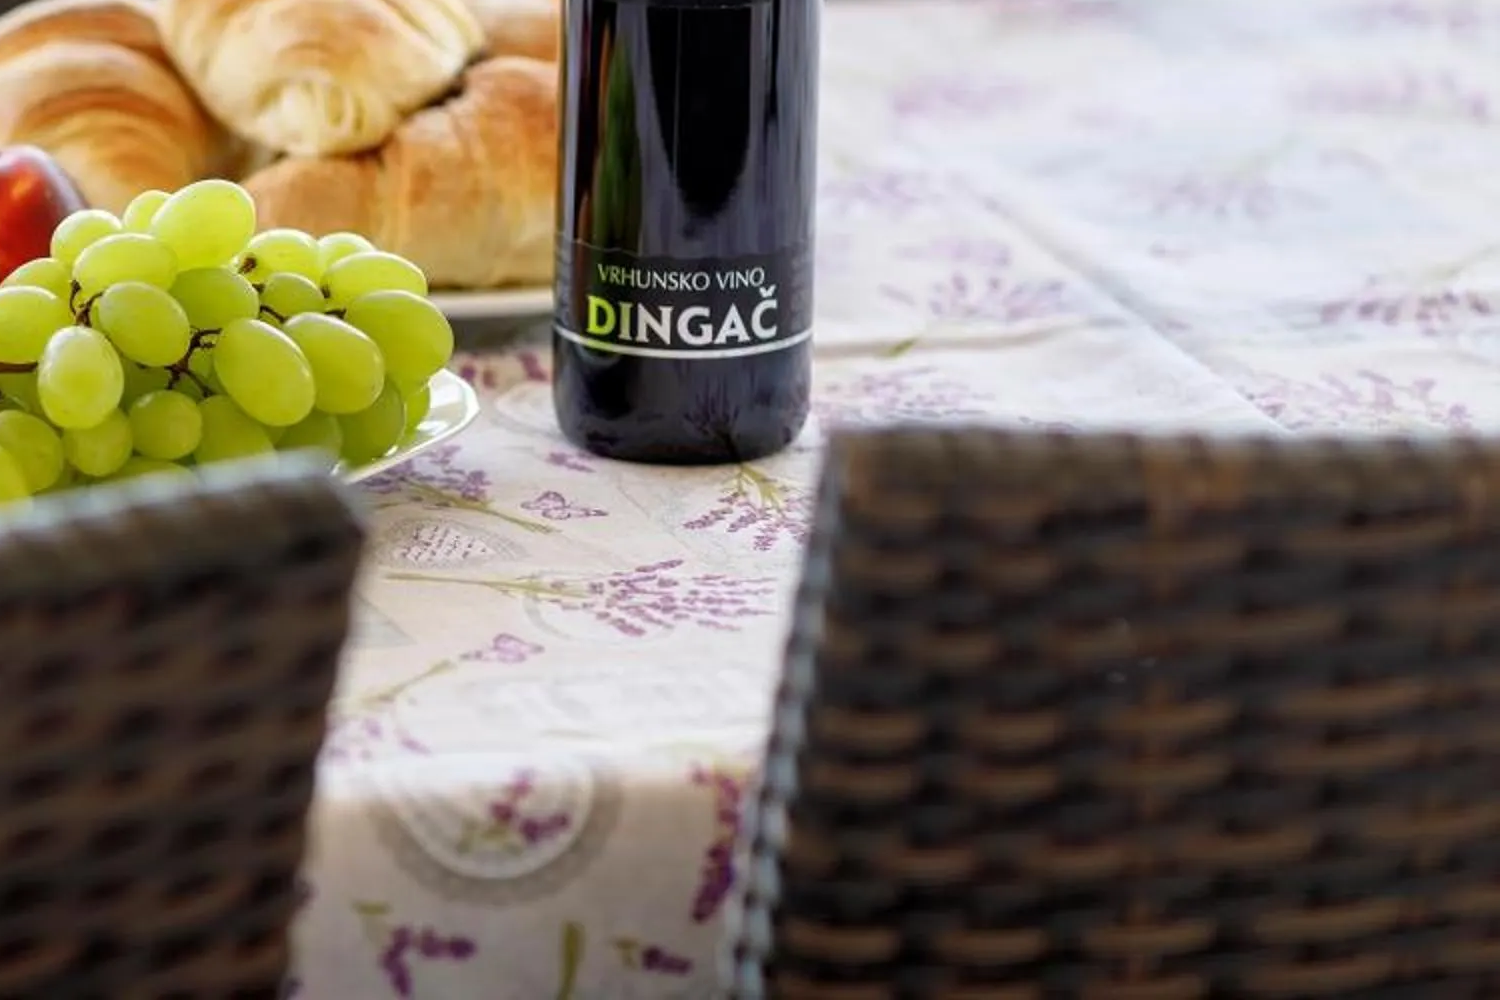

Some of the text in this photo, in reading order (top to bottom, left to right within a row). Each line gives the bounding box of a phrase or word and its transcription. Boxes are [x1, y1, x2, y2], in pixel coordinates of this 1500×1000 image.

[597, 263, 766, 291] VRHUNSKO VINO
[586, 284, 779, 346] DINGAČ
